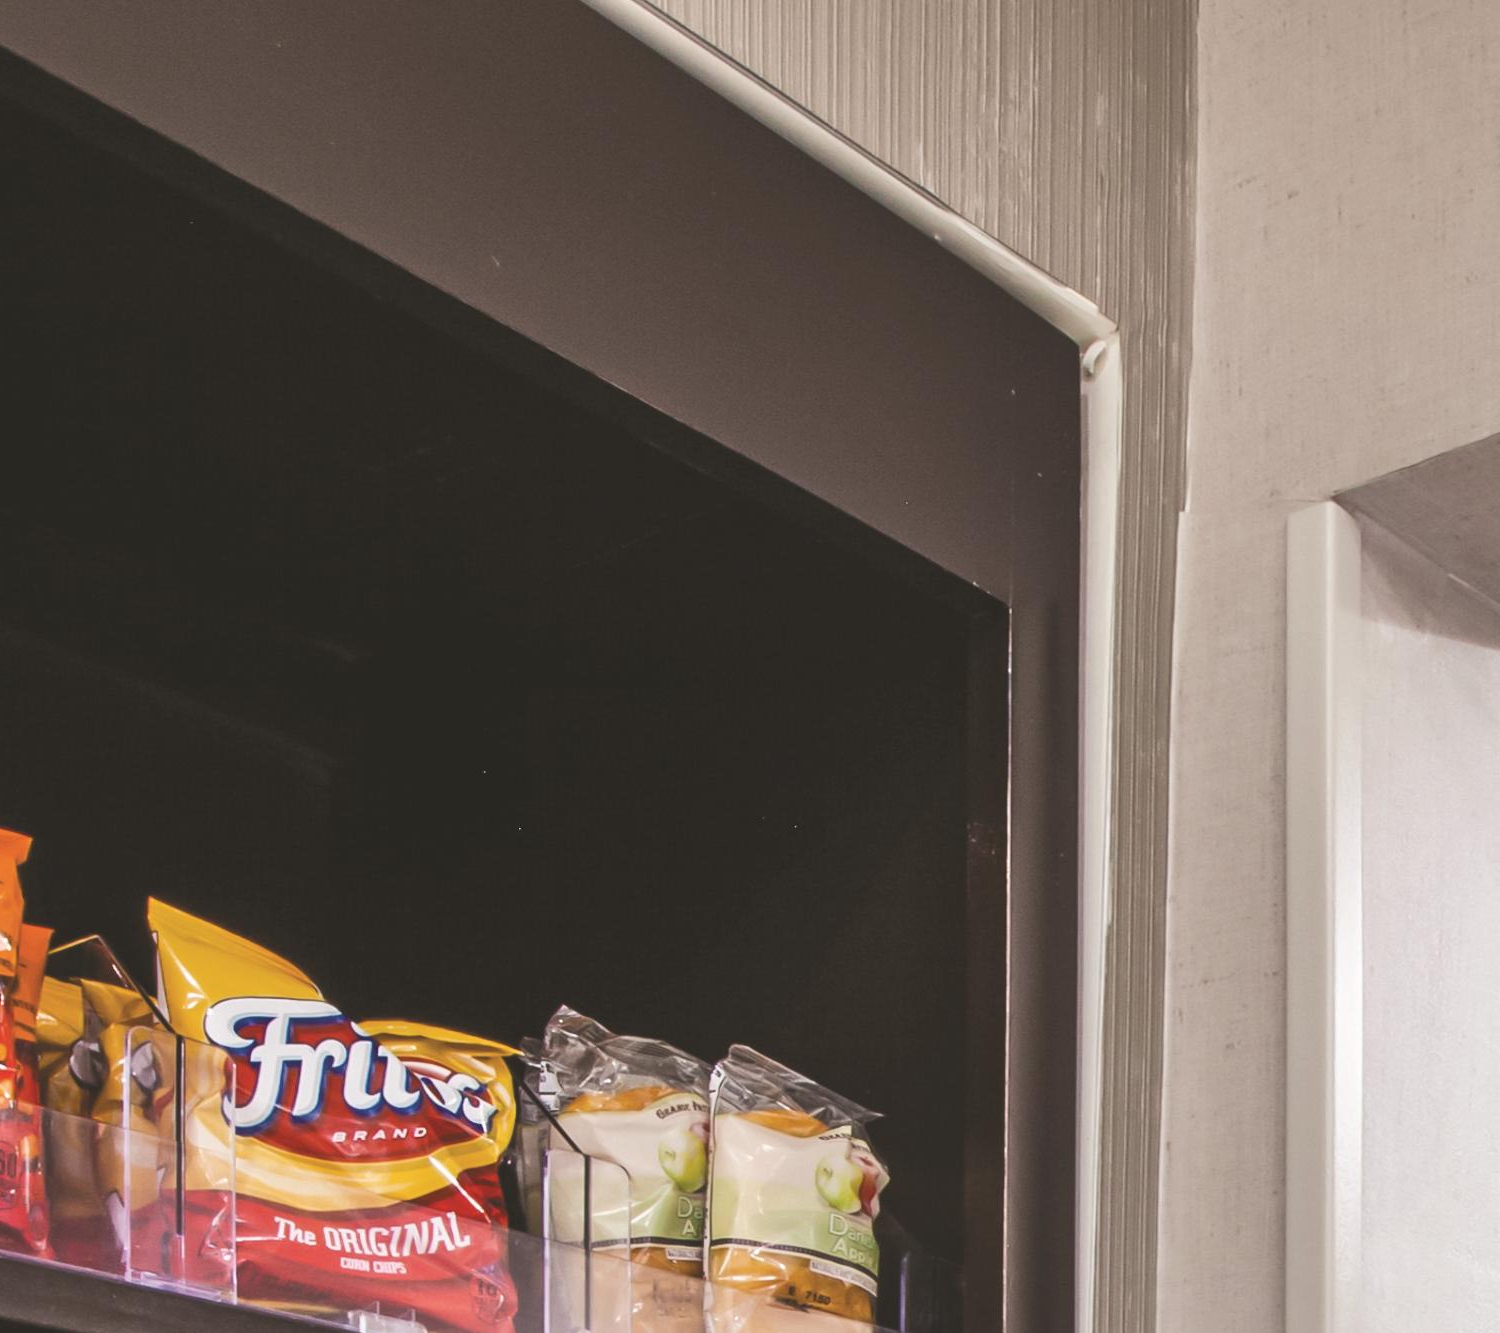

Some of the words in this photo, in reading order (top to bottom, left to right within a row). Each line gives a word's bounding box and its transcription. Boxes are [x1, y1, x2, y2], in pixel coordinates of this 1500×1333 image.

[332, 1125, 430, 1144] BRAND
[274, 1216, 318, 1247] The
[322, 1210, 472, 1258] ORIGINAL
[372, 1258, 408, 1275] CHIPS
